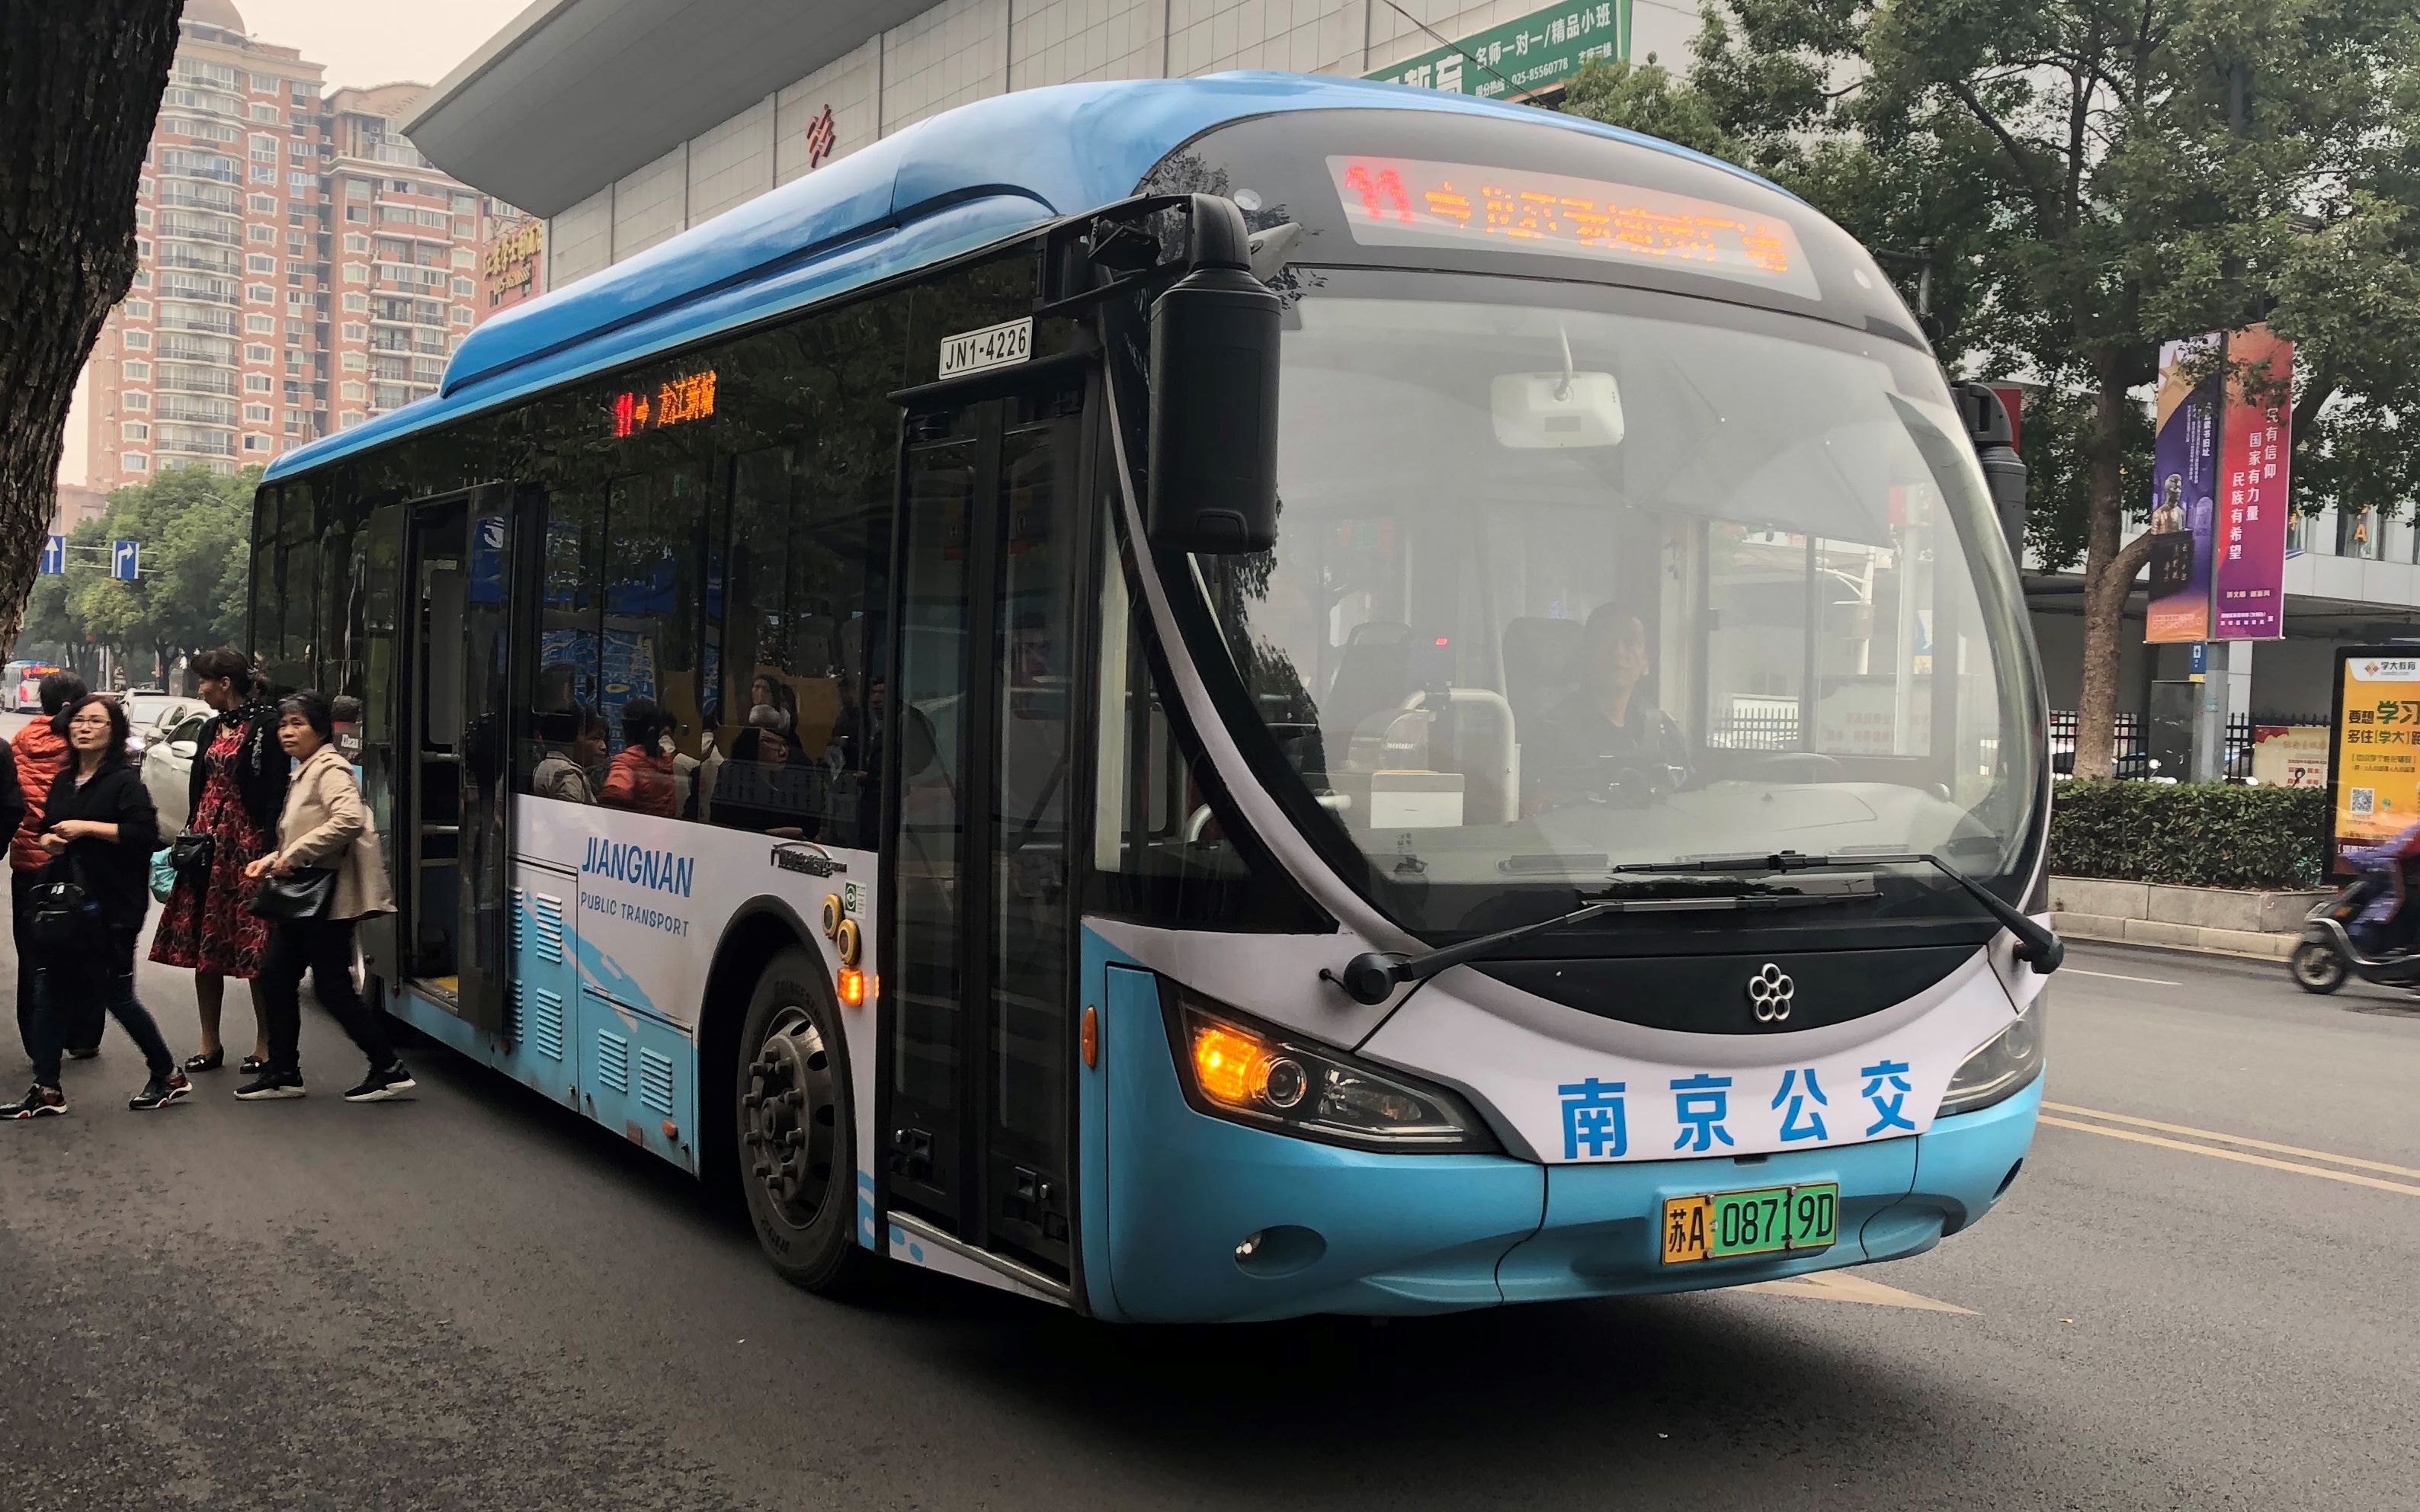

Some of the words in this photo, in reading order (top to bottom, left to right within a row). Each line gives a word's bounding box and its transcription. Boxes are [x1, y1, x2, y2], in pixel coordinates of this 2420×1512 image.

[1475, 2, 1611, 71] 名师一对一/精品小班
[1511, 57, 1569, 85] 025-85560778
[946, 326, 1027, 370] JN1-4226
[2245, 432, 2262, 521] 国家有力量
[2229, 472, 2245, 560] 民族有希望
[2380, 662, 2415, 671] 学大教育
[582, 836, 694, 898] JIANGNAN
[581, 892, 617, 915] PUBLIC
[620, 903, 690, 938] TRANSPORT
[1558, 1060, 1915, 1160] 南京公交
[1668, 1206, 1706, 1254] 苏A
[1721, 1193, 1835, 1248] 08719D
